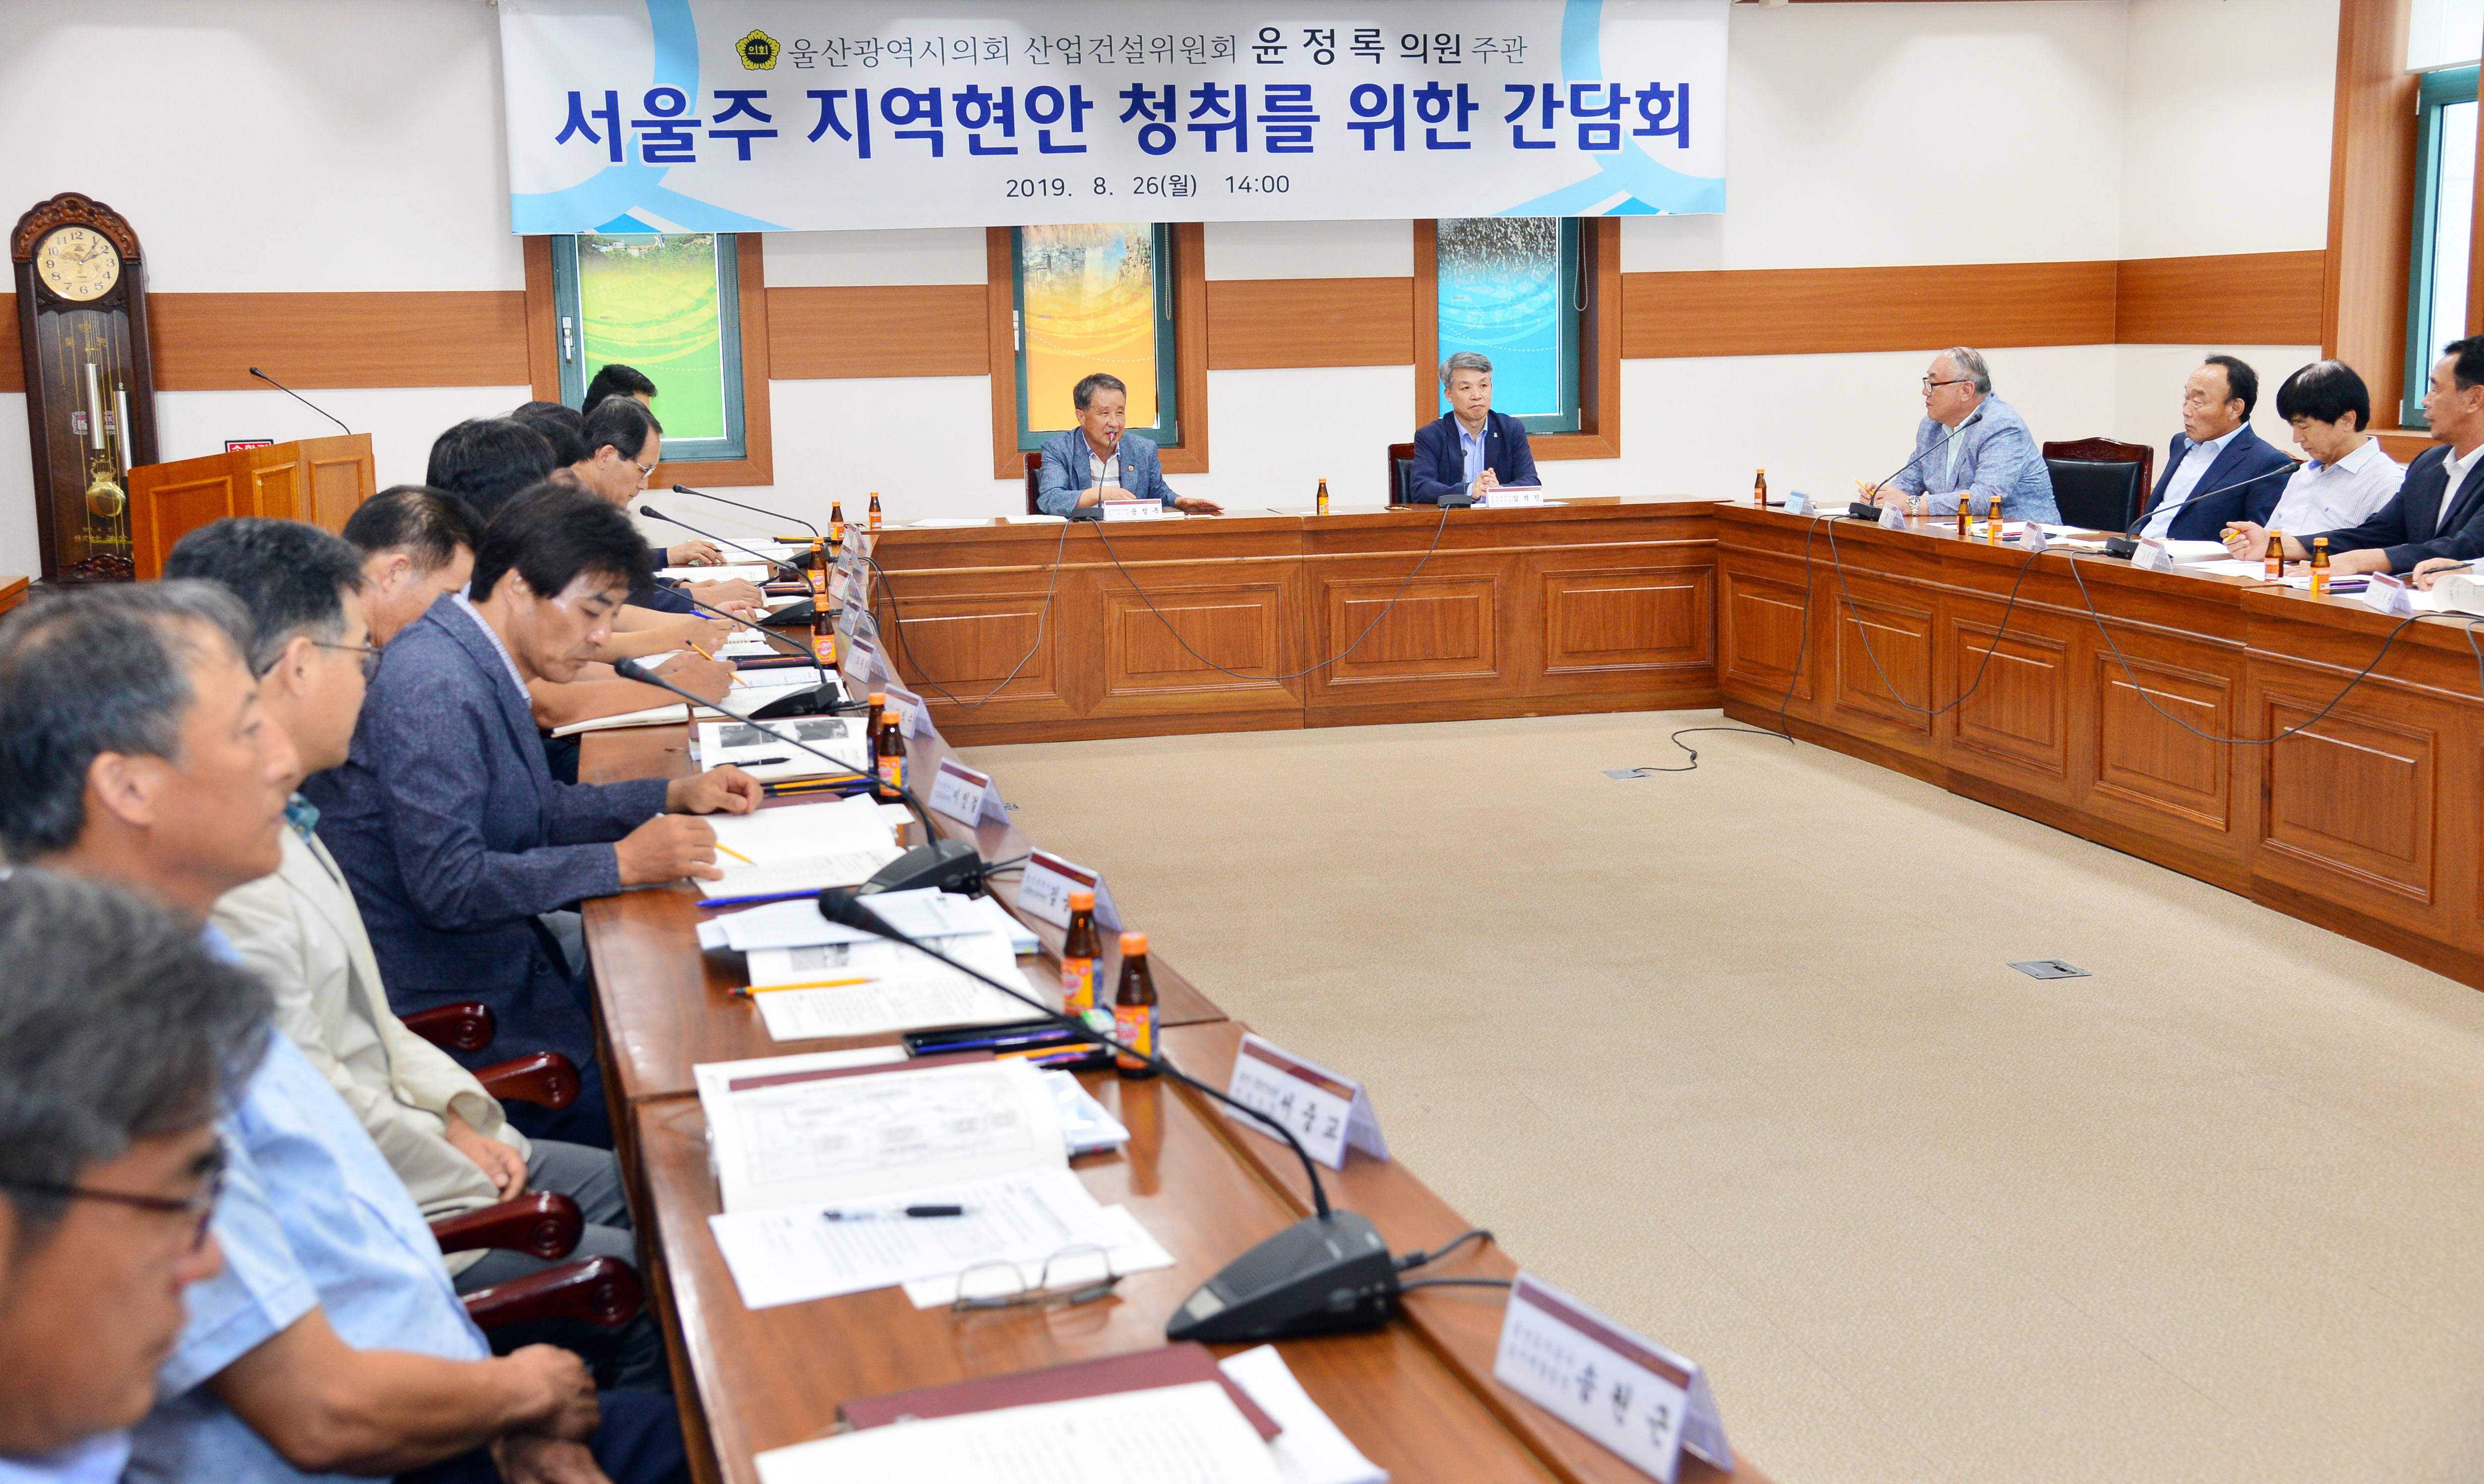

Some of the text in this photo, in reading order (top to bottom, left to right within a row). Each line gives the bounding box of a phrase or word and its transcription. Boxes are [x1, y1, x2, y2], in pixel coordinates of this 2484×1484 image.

[748, 45, 768, 55] 의회
[789, 36, 1009, 70] 울산광역시의회
[1026, 34, 1236, 67] 산업건설위원회
[1401, 34, 1462, 65] 의원
[1472, 35, 1528, 65] 주관
[556, 82, 1690, 163] 서울주 지역현안 청취를 위한 간담회
[1007, 174, 1290, 199] 2019. 8. 26(월) 14:00
[71, 231, 83, 240] 12
[57, 236, 67, 245] 11
[48, 247, 59, 256] 10
[101, 245, 109, 254] 2
[46, 260, 54, 268] 9
[106, 259, 115, 267] 3
[52, 272, 60, 280] 8
[103, 271, 111, 279] 4
[64, 282, 72, 290] 7
[80, 286, 88, 294] 6
[94, 281, 103, 290] 5
